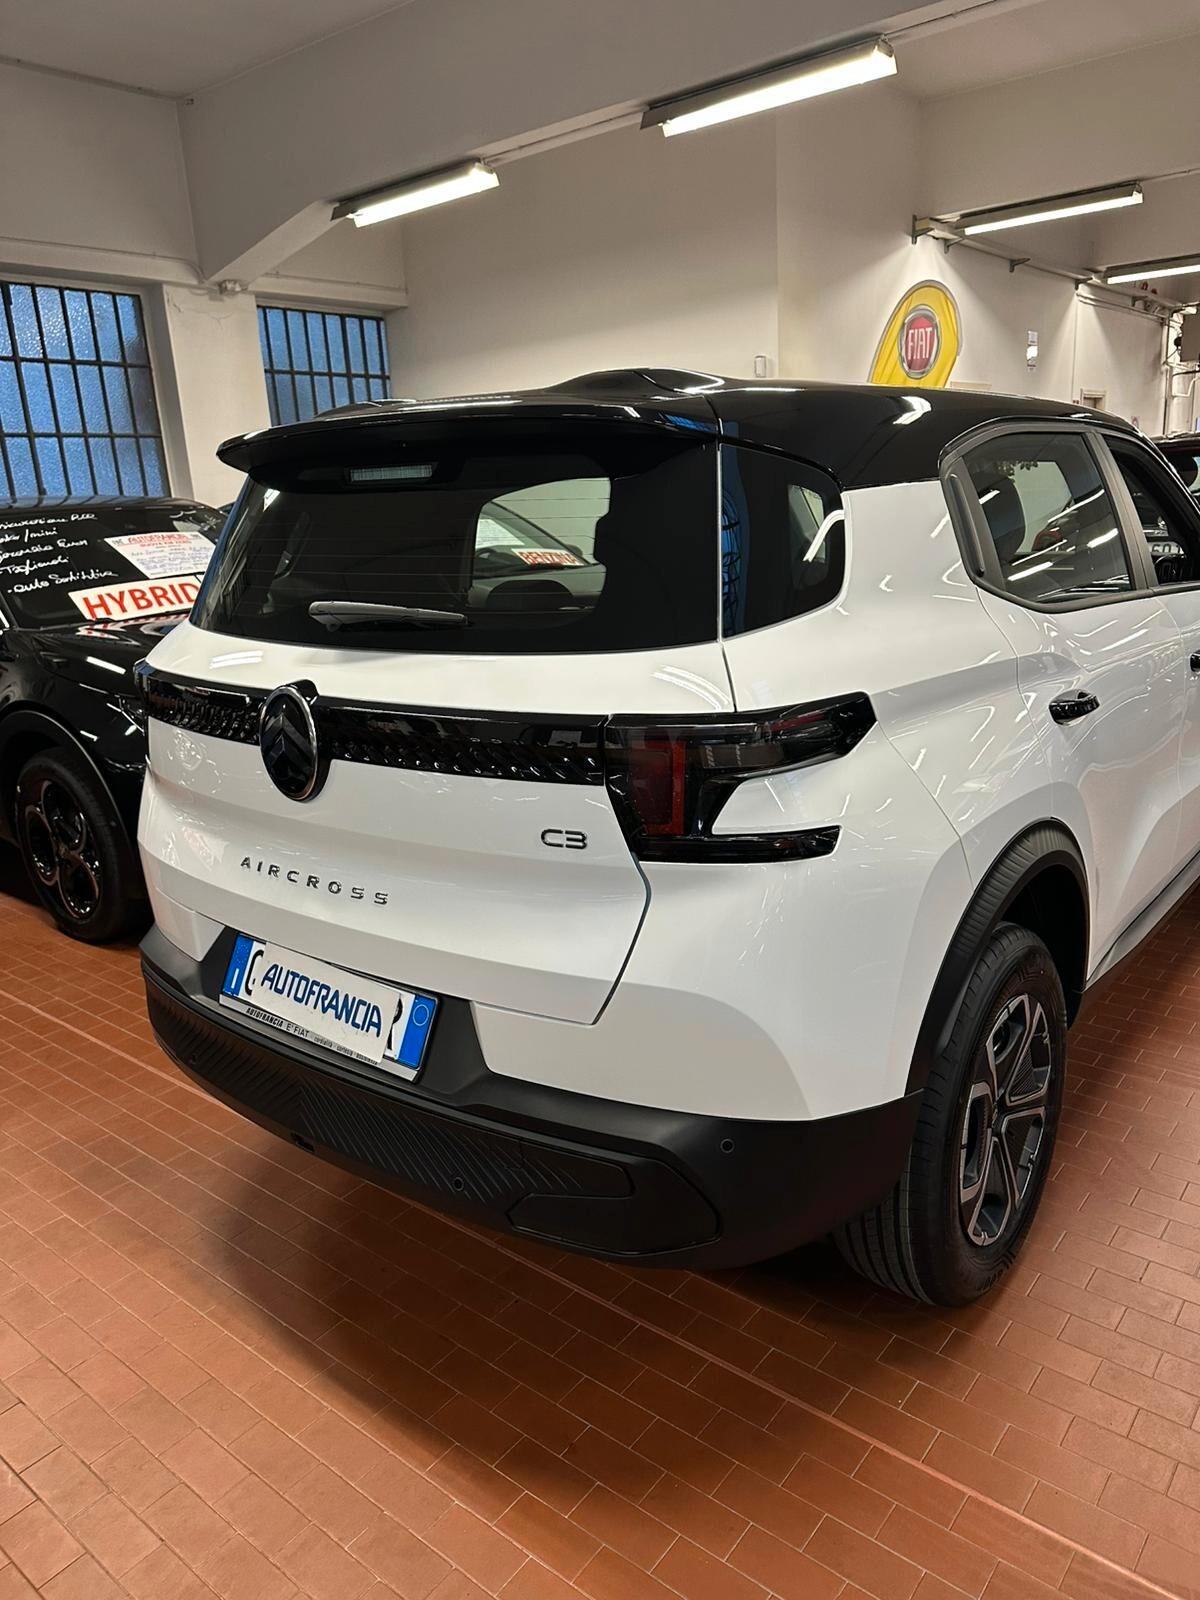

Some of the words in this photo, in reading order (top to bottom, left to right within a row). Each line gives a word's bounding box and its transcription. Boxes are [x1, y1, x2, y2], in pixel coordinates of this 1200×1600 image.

[908, 327, 932, 360] FIAT
[83, 582, 199, 619] HYBRID
[540, 828, 588, 850] C3
[240, 856, 389, 906] AIRCROSS
[245, 1007, 284, 1028] AUTOFRANCIA
[260, 963, 383, 1039] AUTOFRANCIA
